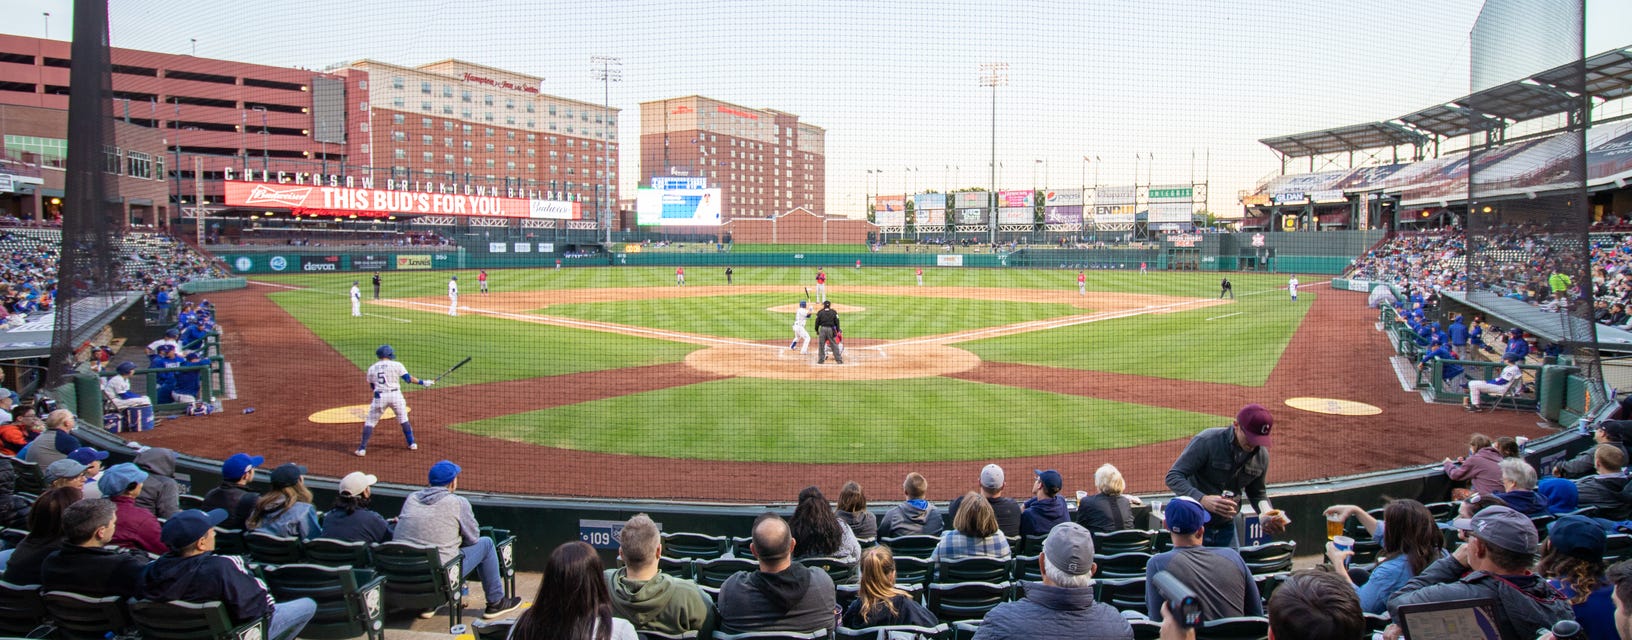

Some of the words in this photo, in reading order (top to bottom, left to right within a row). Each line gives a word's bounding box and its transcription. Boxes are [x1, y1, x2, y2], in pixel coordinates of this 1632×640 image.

[463, 72, 495, 85] Hampton
[224, 166, 374, 189] CHICKASAW
[387, 178, 498, 197] BRICKTOWN
[508, 187, 582, 203] BALLPARK
[253, 187, 307, 201] Budweiser
[1057, 193, 1081, 202] pepsi
[1275, 192, 1304, 202] GILDAN
[321, 187, 369, 210] THIS
[373, 190, 430, 213] BUD'S
[432, 193, 466, 215] FOR
[468, 195, 505, 216] YOU.
[304, 262, 336, 270] devon
[377, 372, 386, 384] 5
[590, 532, 610, 545] 109
